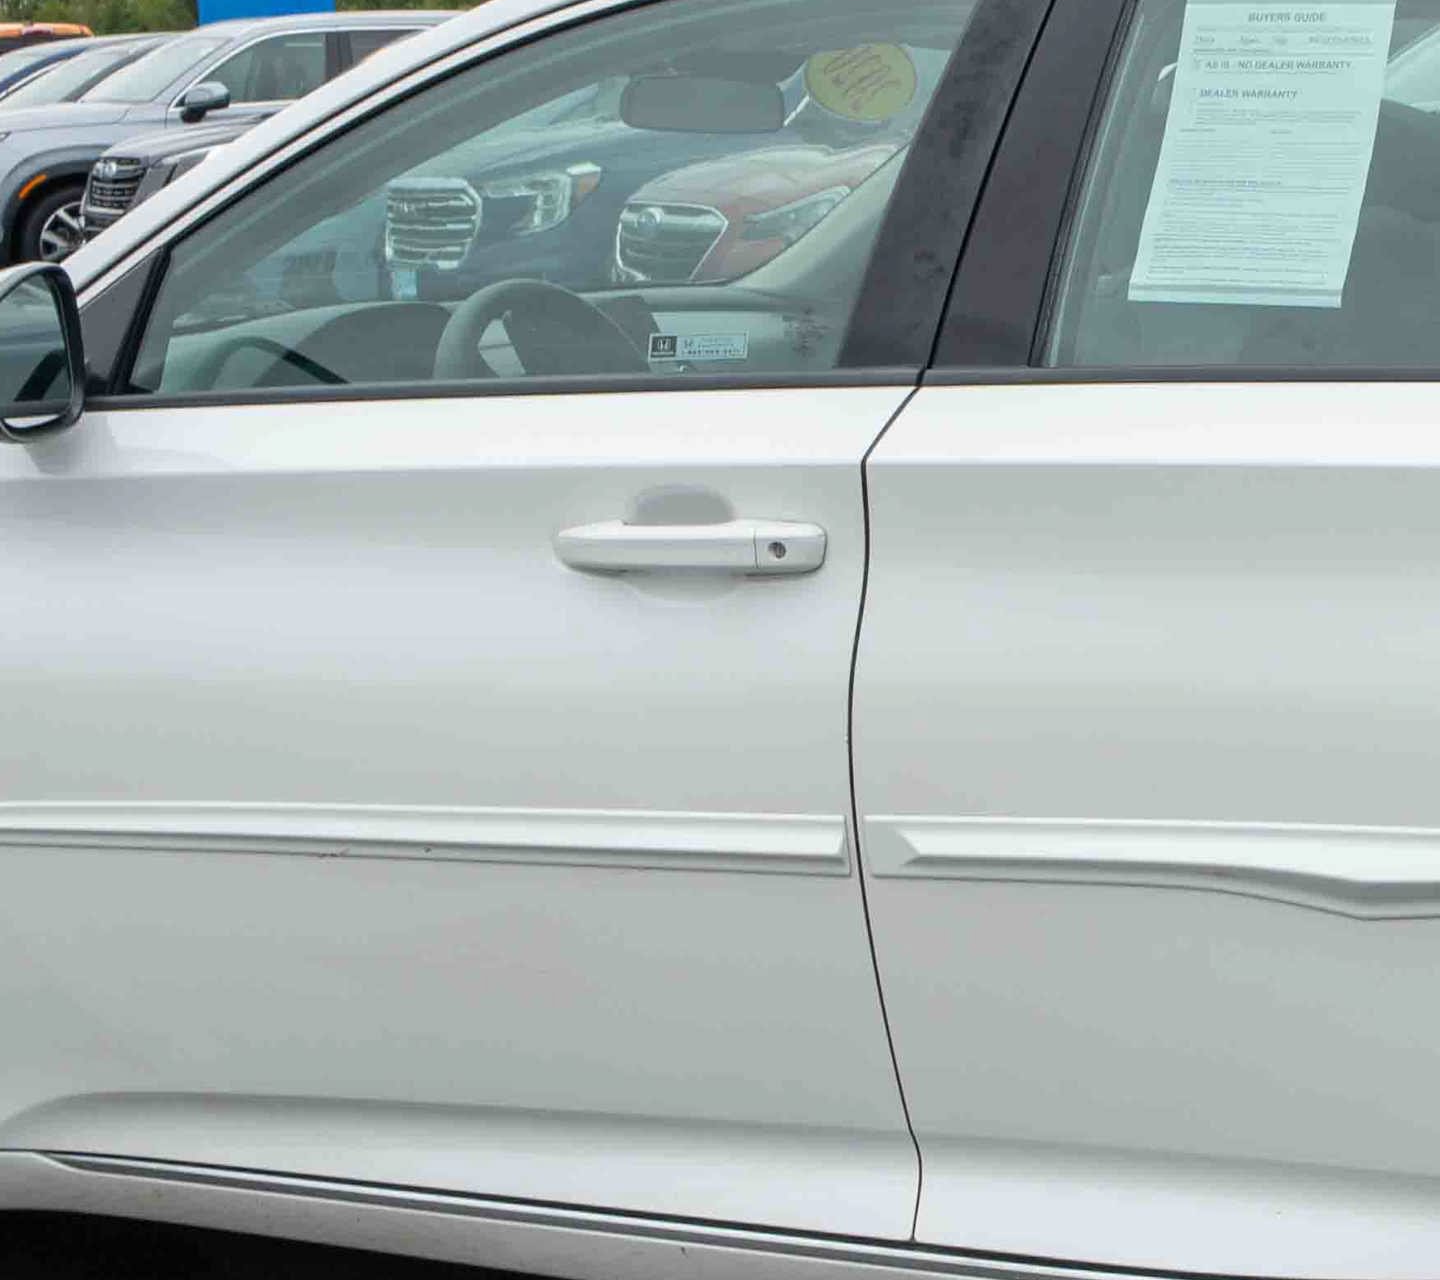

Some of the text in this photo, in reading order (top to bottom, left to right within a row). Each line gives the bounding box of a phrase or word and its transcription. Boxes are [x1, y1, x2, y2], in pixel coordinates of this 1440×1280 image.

[1248, 11, 1327, 22] BUYERS GUIDE
[1237, 61, 1254, 70] NO
[1255, 61, 1294, 71] DEALER
[1296, 61, 1352, 70] WARRANTY
[1200, 88, 1298, 99] DEALER WARRANTY
